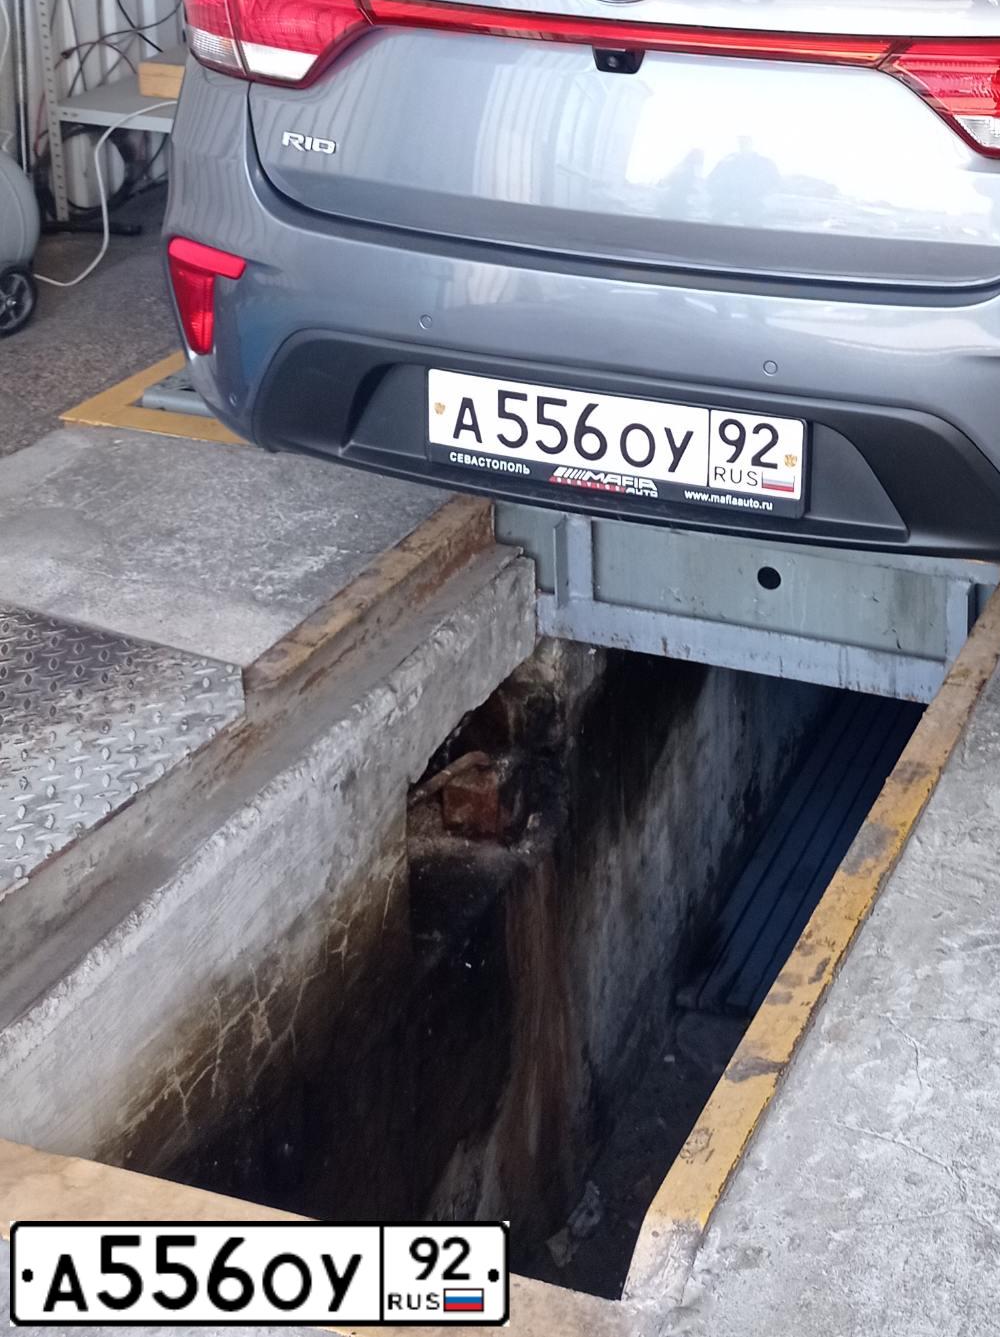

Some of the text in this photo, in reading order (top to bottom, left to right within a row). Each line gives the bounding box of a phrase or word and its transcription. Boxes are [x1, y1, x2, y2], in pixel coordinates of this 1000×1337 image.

[282, 131, 336, 154] RIO
[718, 418, 779, 470] 92
[449, 451, 531, 476] СЕВАСТОПОЛЬ
[581, 470, 658, 492] MAFIA
[714, 466, 759, 488] RUS
[626, 487, 659, 499] AUTO
[684, 490, 773, 511] www.mafiaauto.ru
